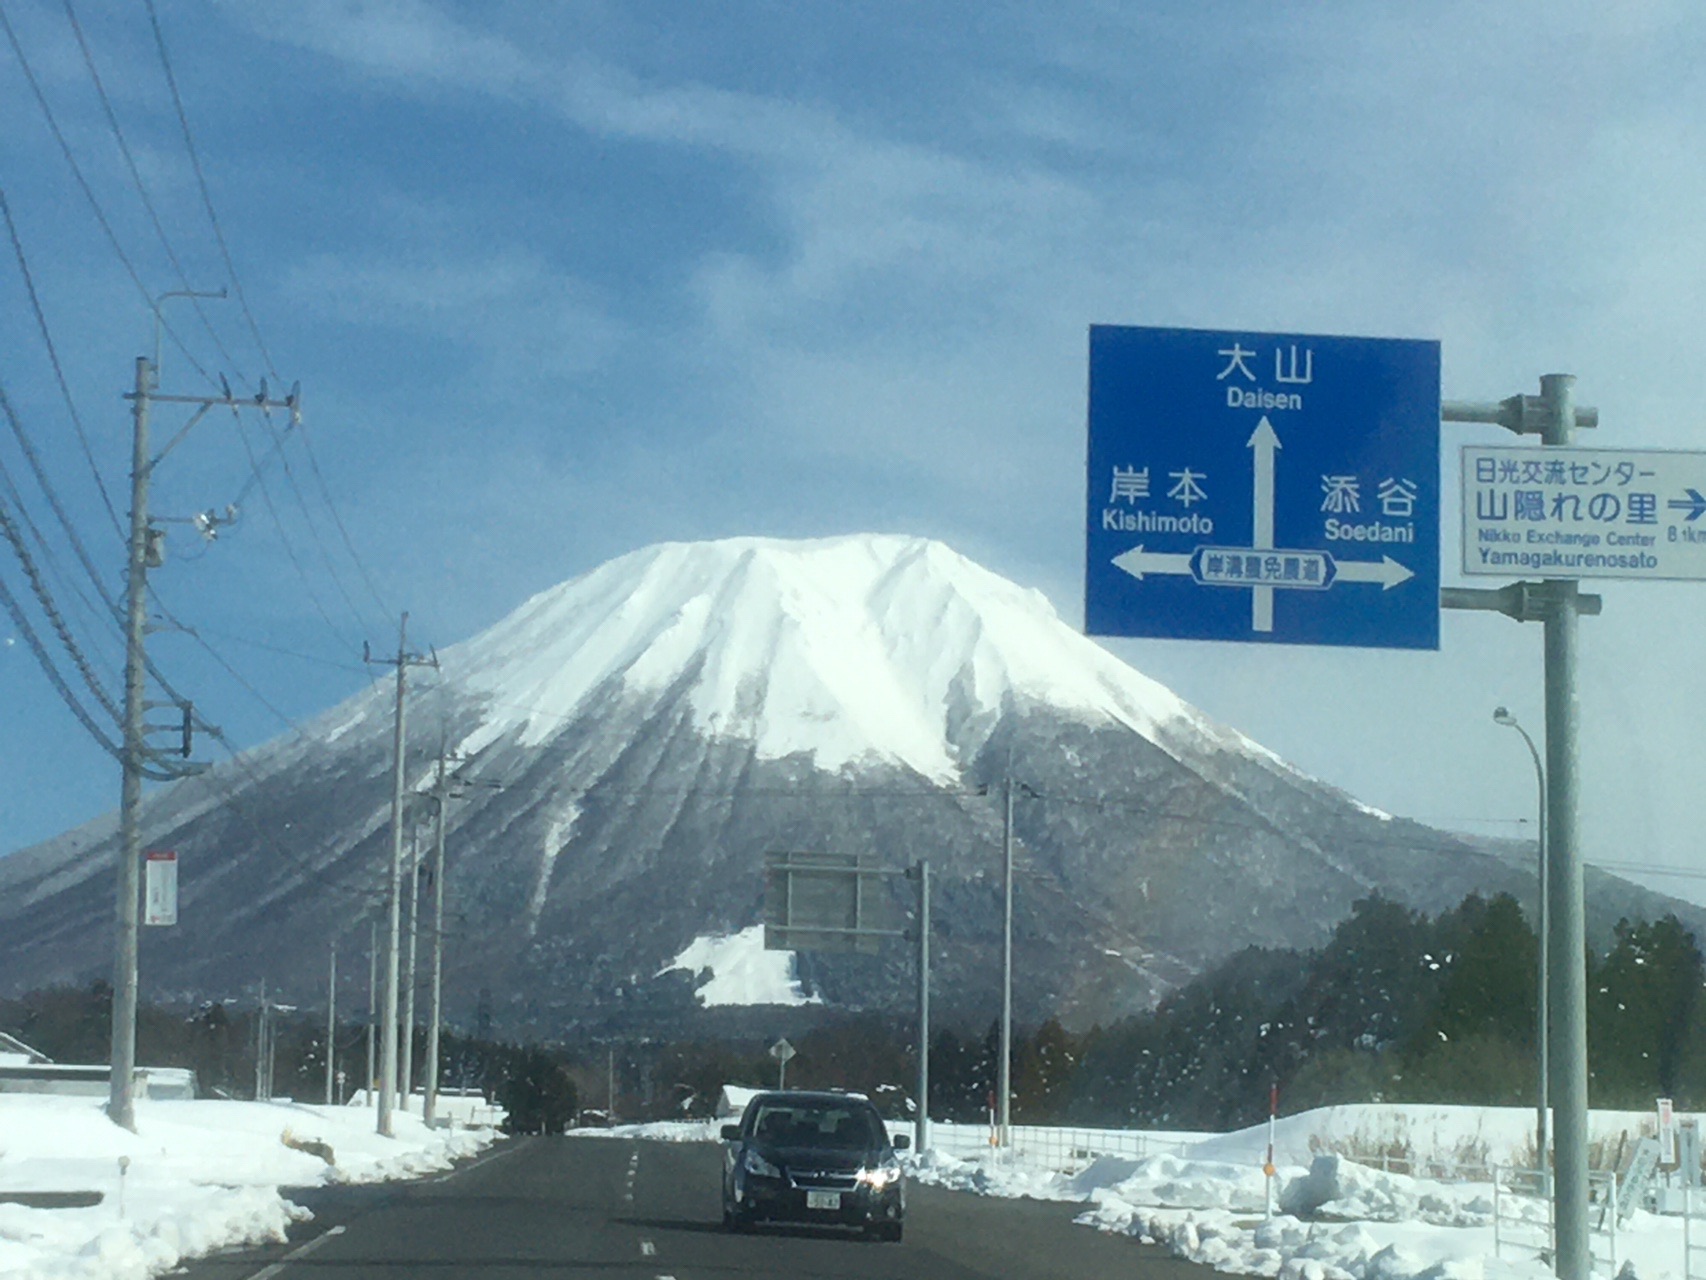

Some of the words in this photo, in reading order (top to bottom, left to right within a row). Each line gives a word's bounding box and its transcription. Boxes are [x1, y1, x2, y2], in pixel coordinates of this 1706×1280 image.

[1216, 343, 1313, 384] 大山
[1227, 387, 1302, 410] Daisen
[1476, 457, 1656, 486] 日光交流センター
[1109, 465, 1208, 508] 岸本
[1320, 474, 1418, 517] 添谷
[1476, 489, 1658, 525] 山隠れの里
[1102, 510, 1213, 535] Kishimoto
[1324, 519, 1414, 543] Soedani
[1478, 528, 1521, 544] Nikko
[1526, 530, 1600, 547] Exchange
[1606, 531, 1656, 547] Center
[1478, 547, 1658, 569] Yamagakurenosato
